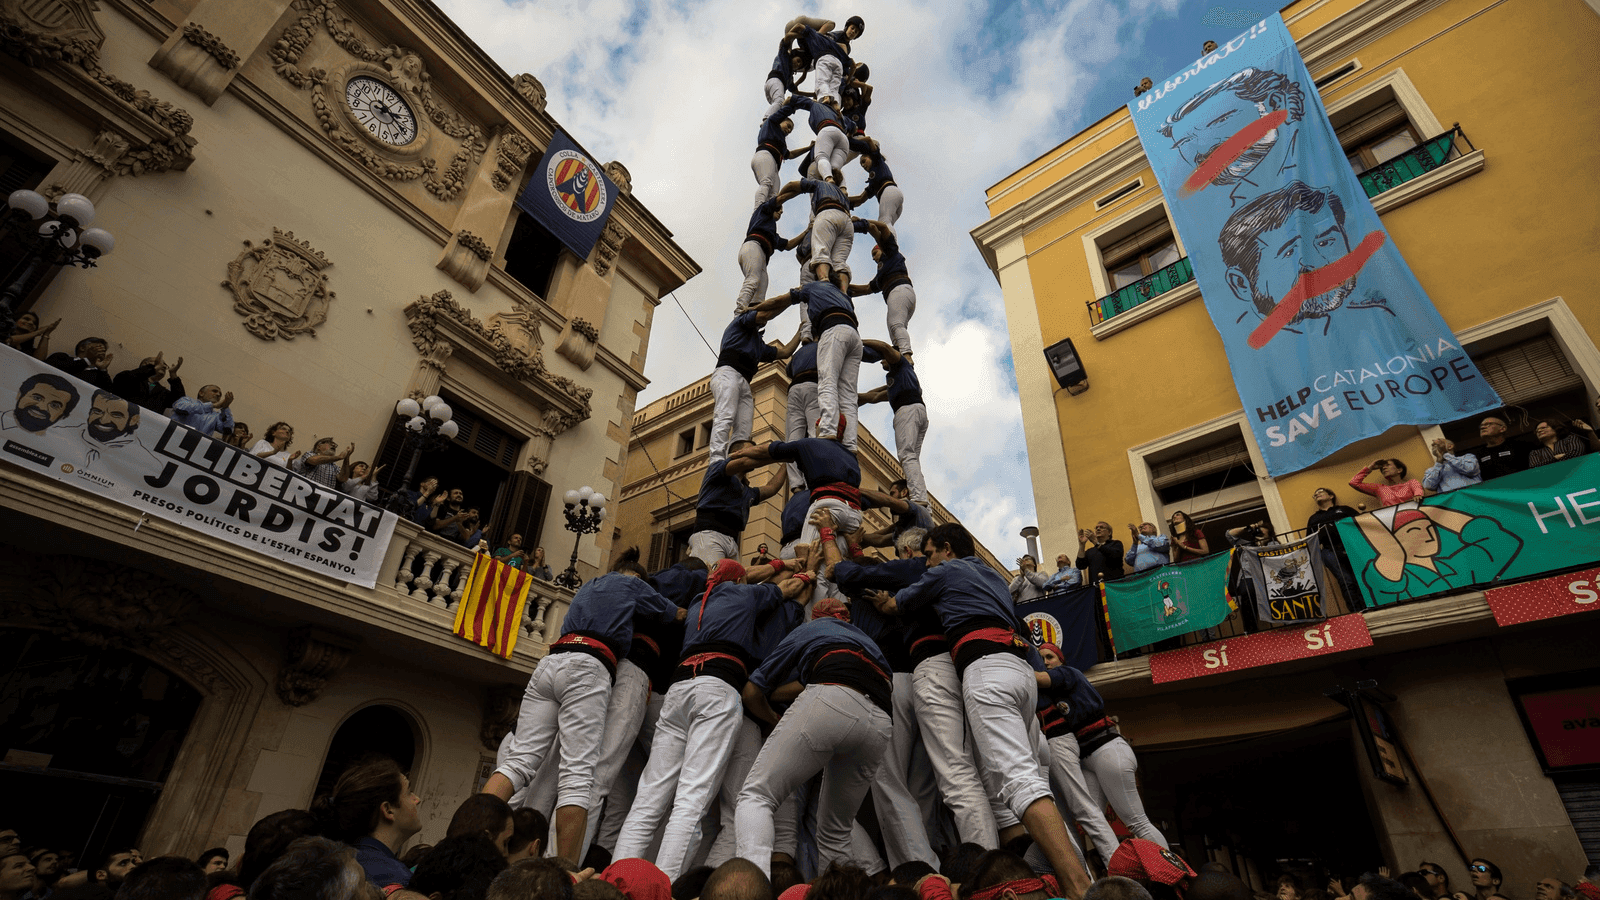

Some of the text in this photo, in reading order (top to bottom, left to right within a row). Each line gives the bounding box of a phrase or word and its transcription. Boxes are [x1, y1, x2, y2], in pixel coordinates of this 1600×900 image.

[354, 89, 362, 98] 9
[361, 84, 370, 94] 10
[374, 86, 381, 95] 11
[386, 93, 394, 104] 12
[352, 100, 360, 108] 8
[402, 118, 408, 126] 2
[368, 123, 376, 132] 6
[382, 130, 389, 140] 5
[560, 150, 578, 158] COLLA
[568, 210, 576, 218] DE
[1256, 338, 1457, 423] HELP CATALONIA
[1265, 356, 1476, 448] SAVE EUROPE
[163, 425, 381, 532] LLIBERTAT
[144, 461, 365, 561] JORDIS!
[133, 490, 357, 576] PRESOS POLÍTICS DE L'ESTAT ESPANYOL
[1568, 574, 1600, 604] S
[1270, 594, 1324, 620] SANTS
